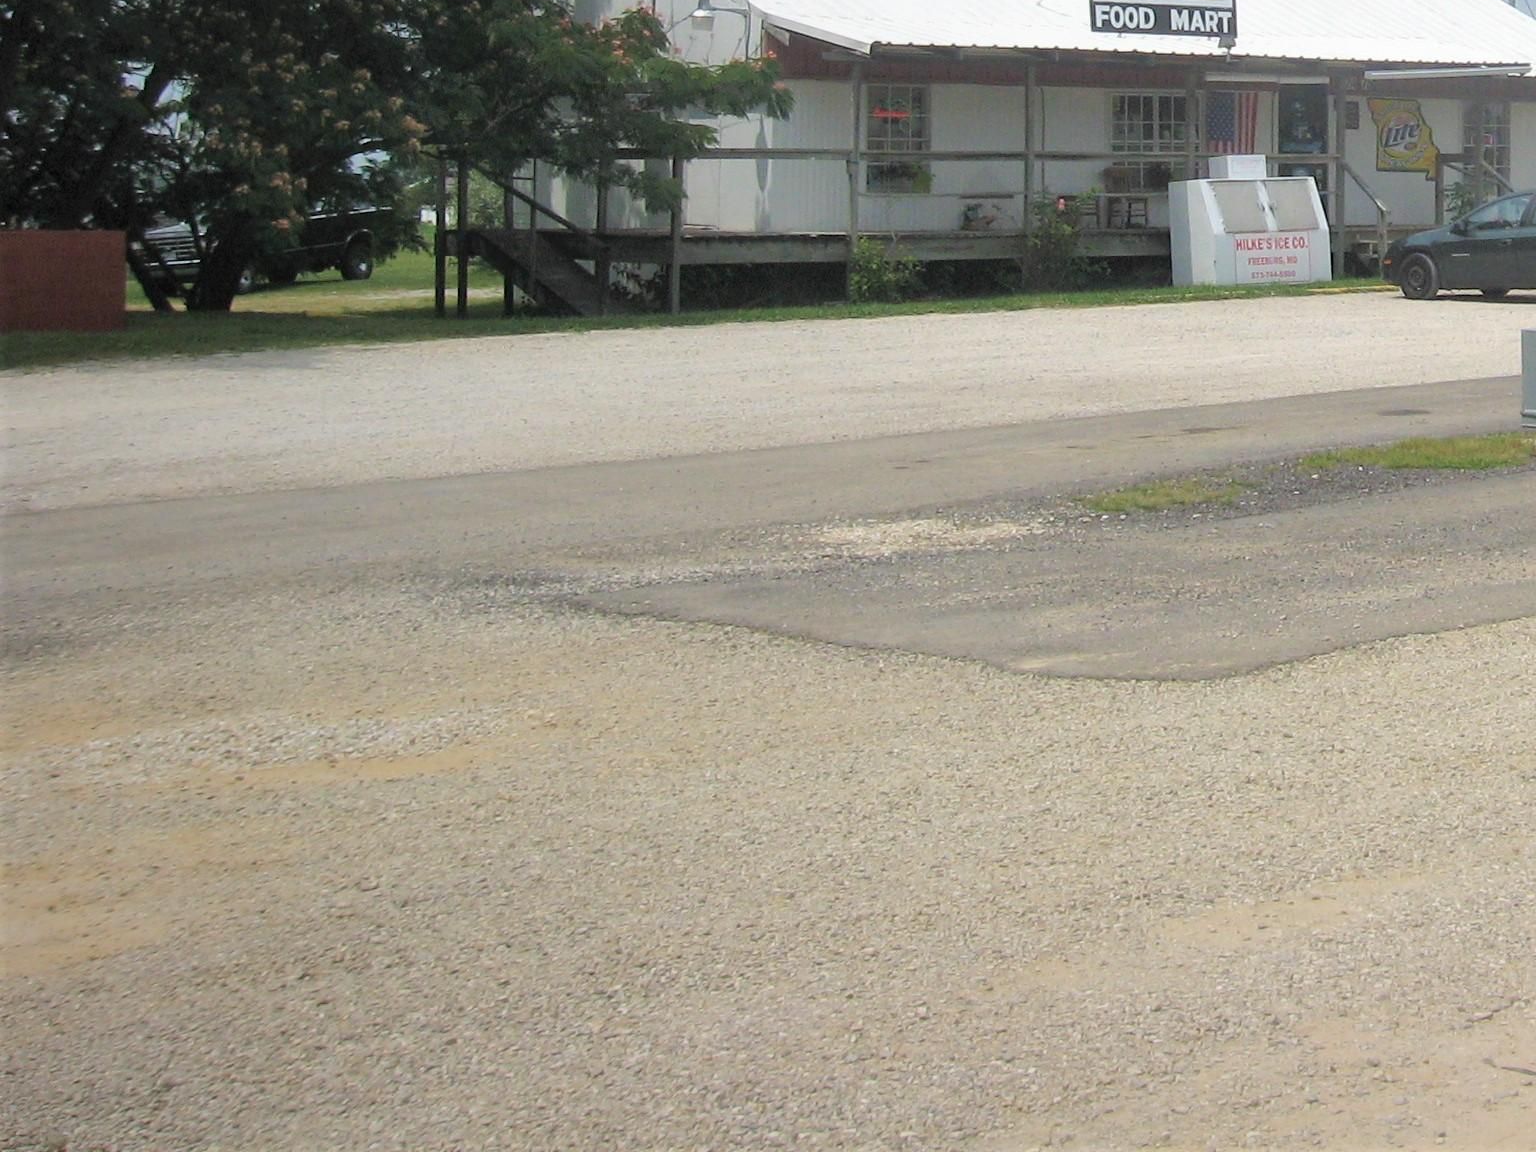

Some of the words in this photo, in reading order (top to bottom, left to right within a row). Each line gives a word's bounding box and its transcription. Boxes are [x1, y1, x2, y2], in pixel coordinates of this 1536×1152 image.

[1095, 5, 1156, 30] FOOD
[1171, 9, 1233, 34] MART
[1236, 237, 1272, 251] HILKE'S
[1275, 237, 1290, 249] ICE
[1292, 236, 1308, 249] CO.
